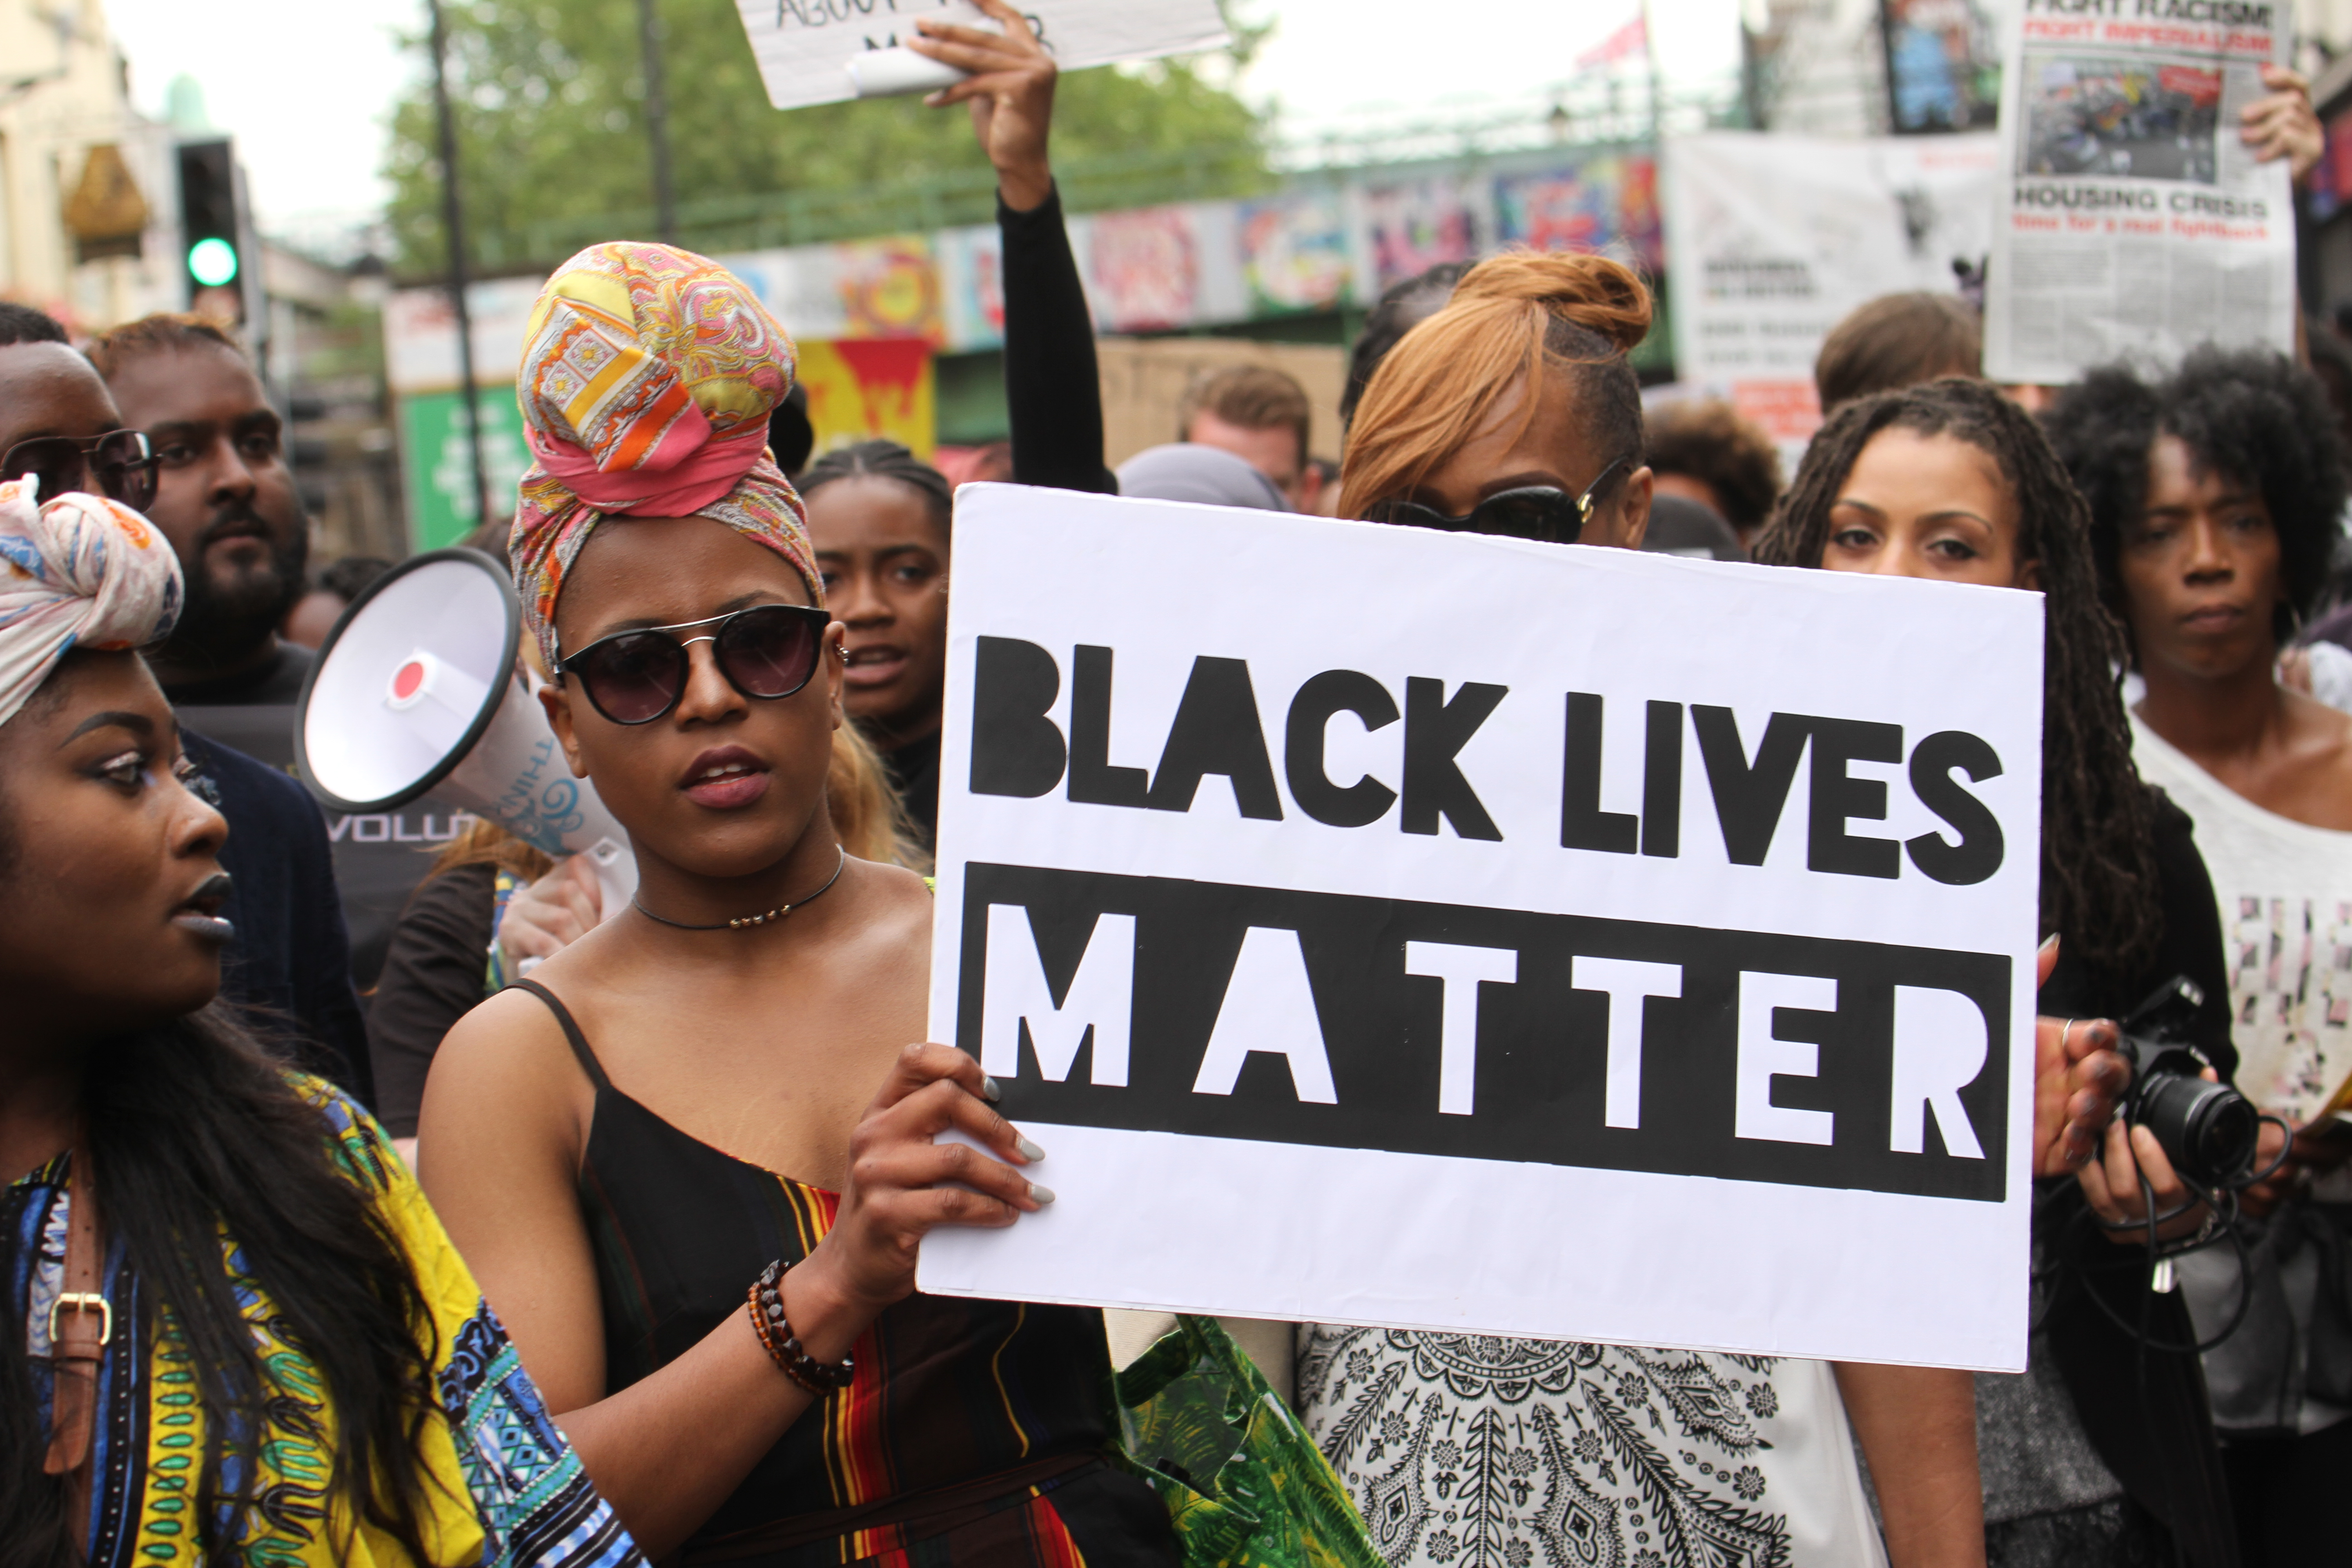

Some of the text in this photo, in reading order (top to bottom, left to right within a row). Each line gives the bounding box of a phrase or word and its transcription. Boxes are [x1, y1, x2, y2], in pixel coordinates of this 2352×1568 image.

[2013, 186, 2269, 218] HOUSING CRISIS
[970, 636, 2004, 886] BLACK LIVES
[979, 903, 1989, 1161] MATTER
